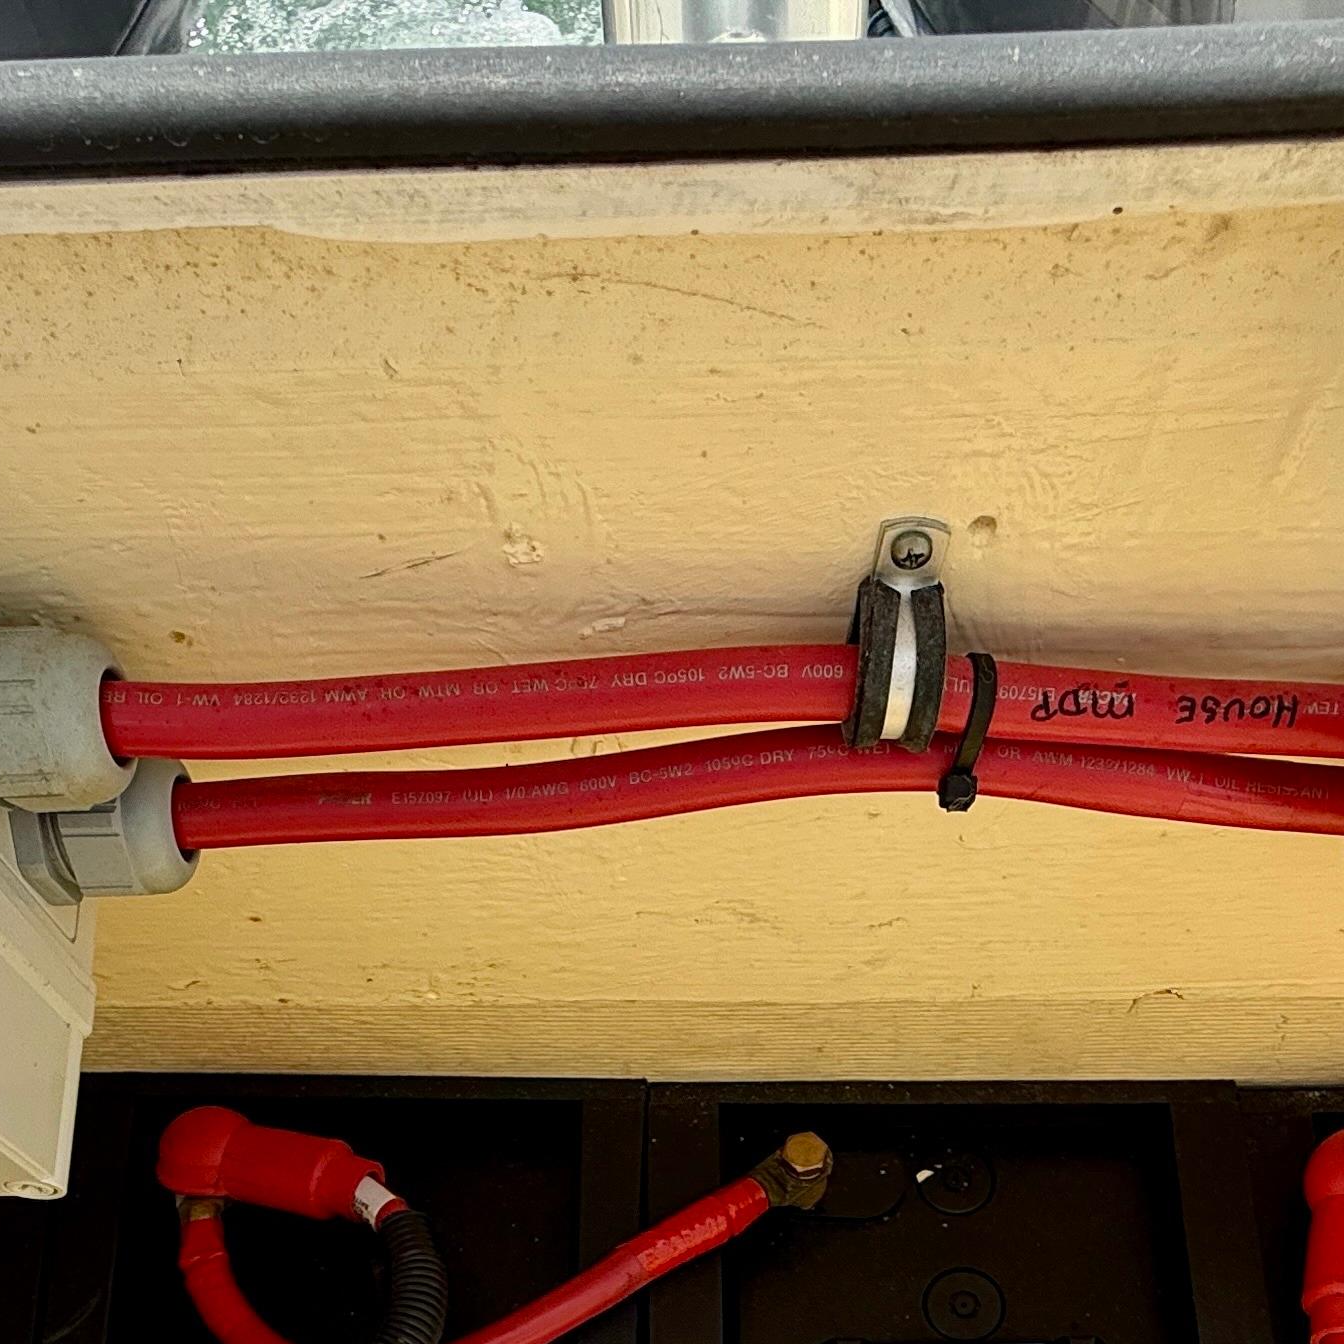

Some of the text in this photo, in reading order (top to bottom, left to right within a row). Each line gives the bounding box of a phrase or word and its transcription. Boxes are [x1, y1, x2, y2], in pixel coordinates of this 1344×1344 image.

[612, 671, 647, 686] DRY
[800, 663, 844, 680] 600V
[418, 683, 460, 699] MTW
[473, 682, 498, 695] OR
[511, 677, 549, 693] WET
[996, 685, 1055, 701] E15709
[176, 692, 220, 707] VW-1
[325, 687, 368, 703] AWM
[1174, 694, 1299, 729] HOUSE
[532, 781, 569, 798] AWG
[579, 775, 617, 792] 600V
[760, 749, 794, 765] DRY
